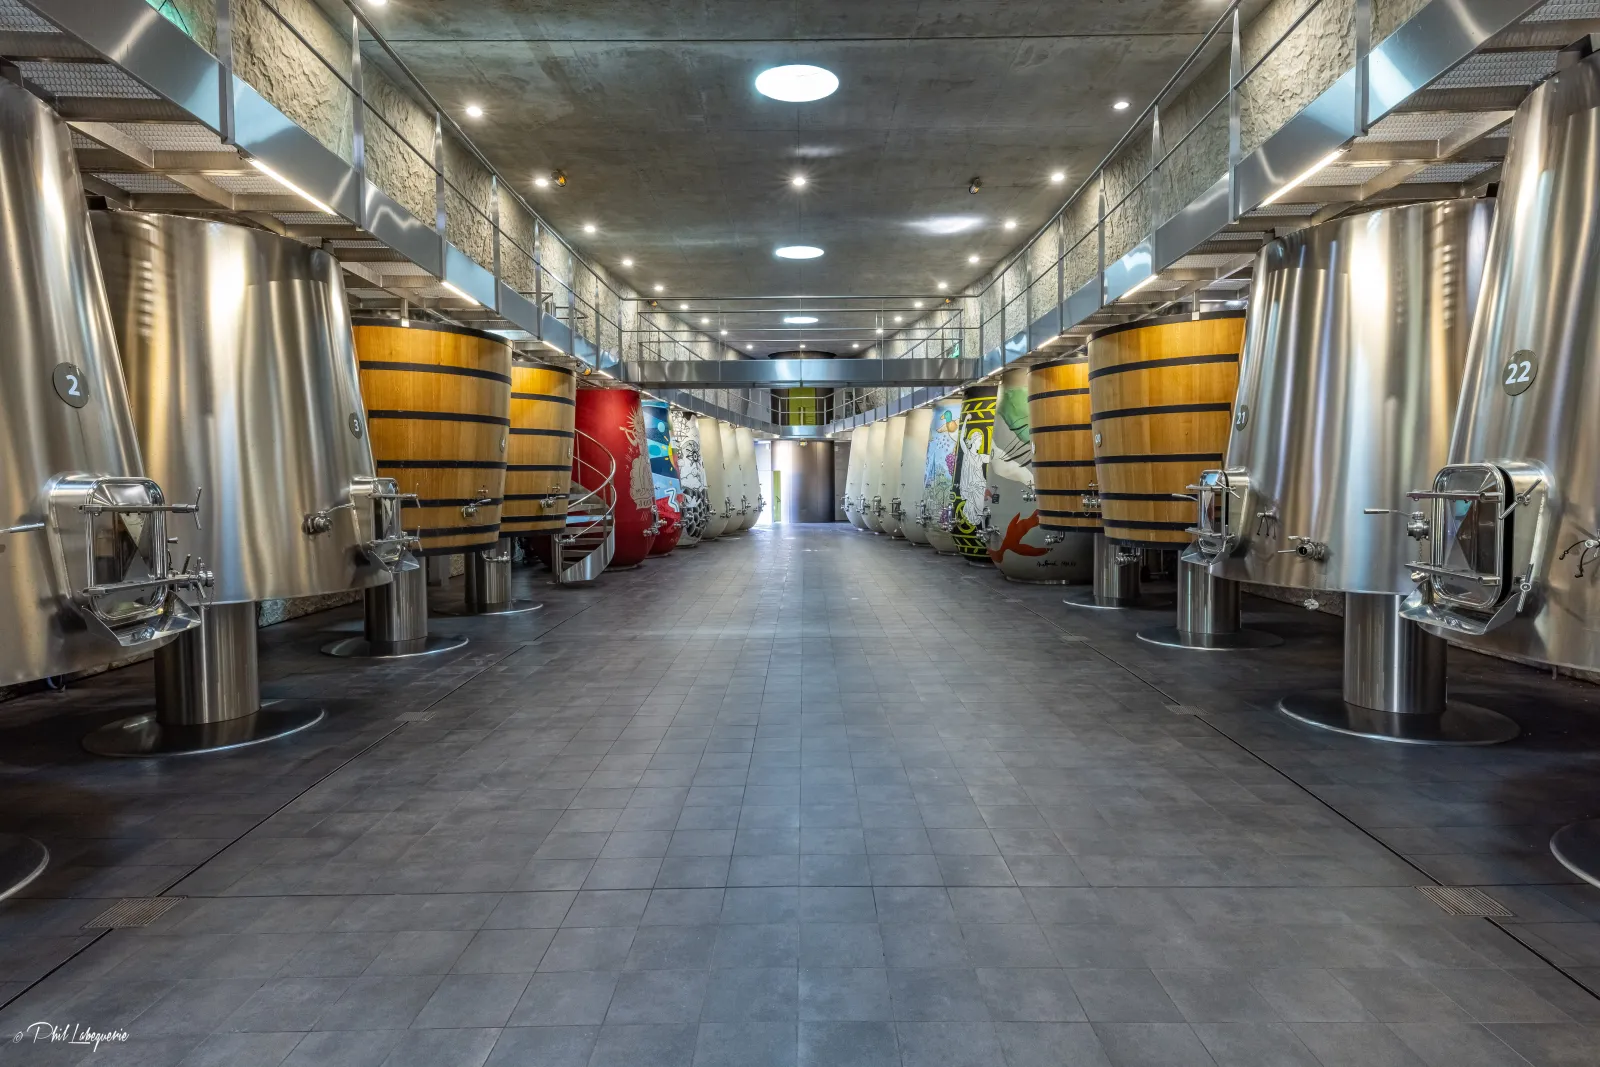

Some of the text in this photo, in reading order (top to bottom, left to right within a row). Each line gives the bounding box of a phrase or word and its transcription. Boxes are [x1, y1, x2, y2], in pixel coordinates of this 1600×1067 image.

[1505, 360, 1532, 385] 22
[65, 374, 81, 397] 2
[353, 419, 359, 431] 3
[1236, 411, 1246, 424] 21
